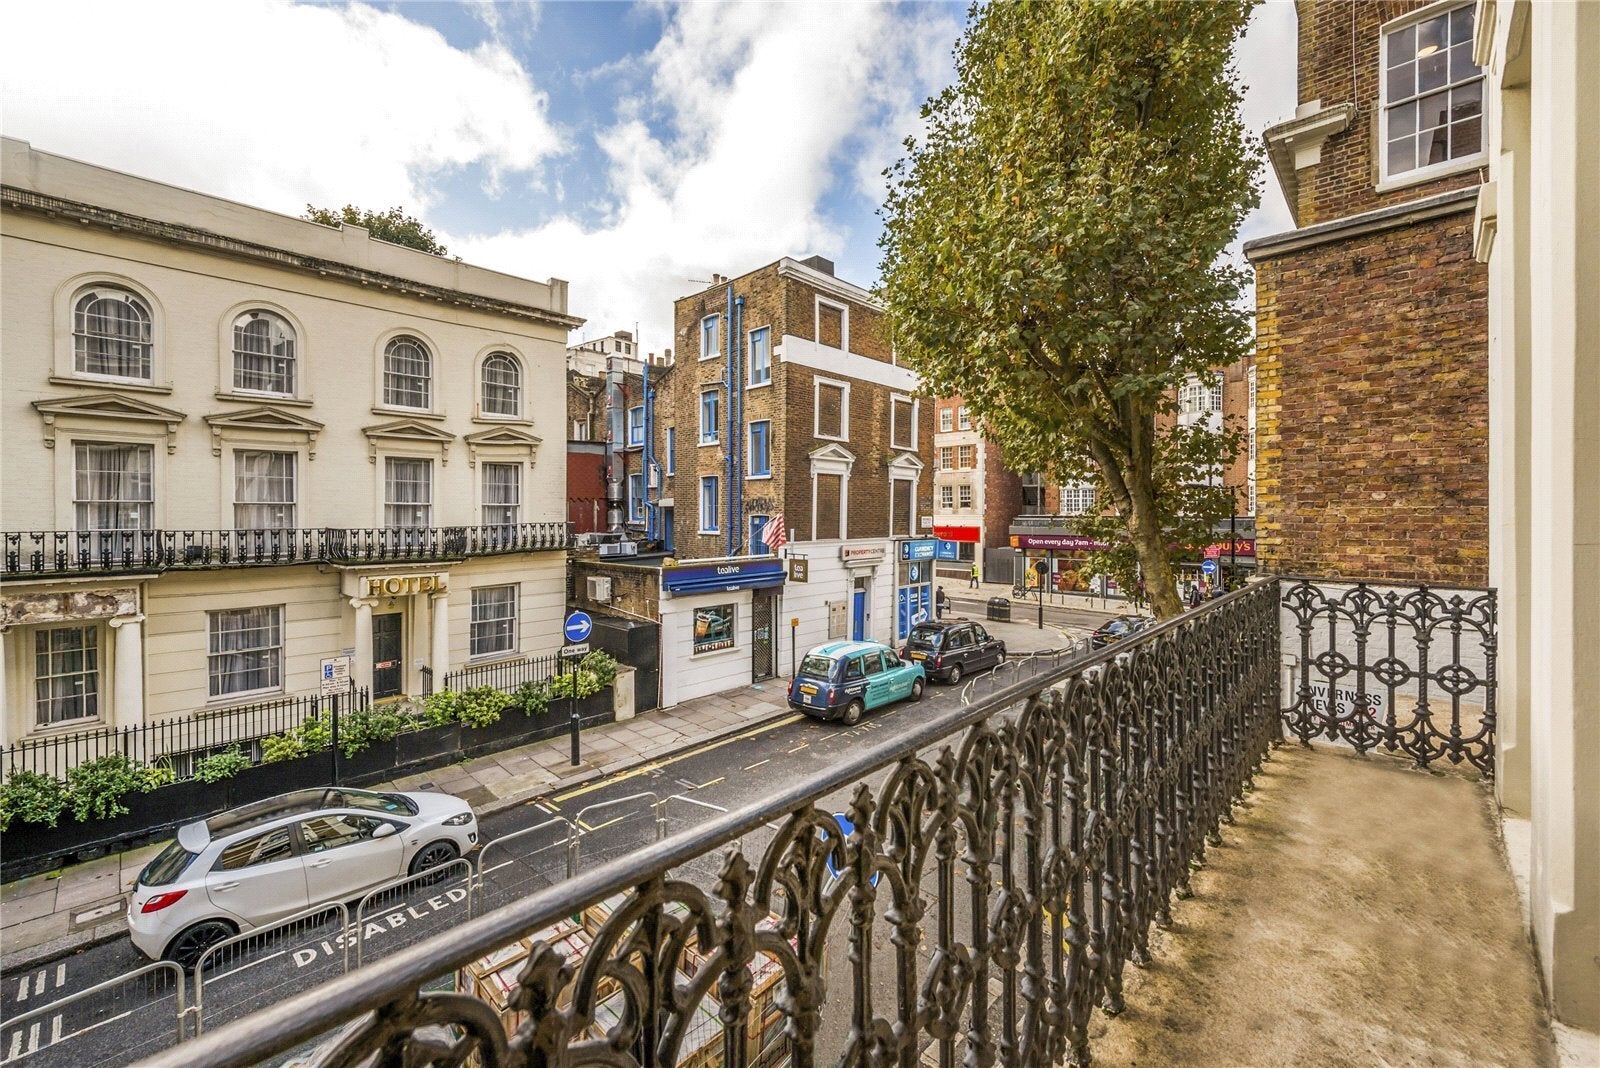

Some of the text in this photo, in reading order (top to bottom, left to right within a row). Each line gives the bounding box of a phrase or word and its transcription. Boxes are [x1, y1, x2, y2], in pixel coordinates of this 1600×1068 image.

[1044, 539, 1061, 547] every
[1061, 539, 1074, 547] day
[717, 565, 740, 575] tealive
[367, 575, 447, 596] HOTEL
[1306, 685, 1382, 706] NVRNSS
[292, 888, 468, 968] DISABLED
